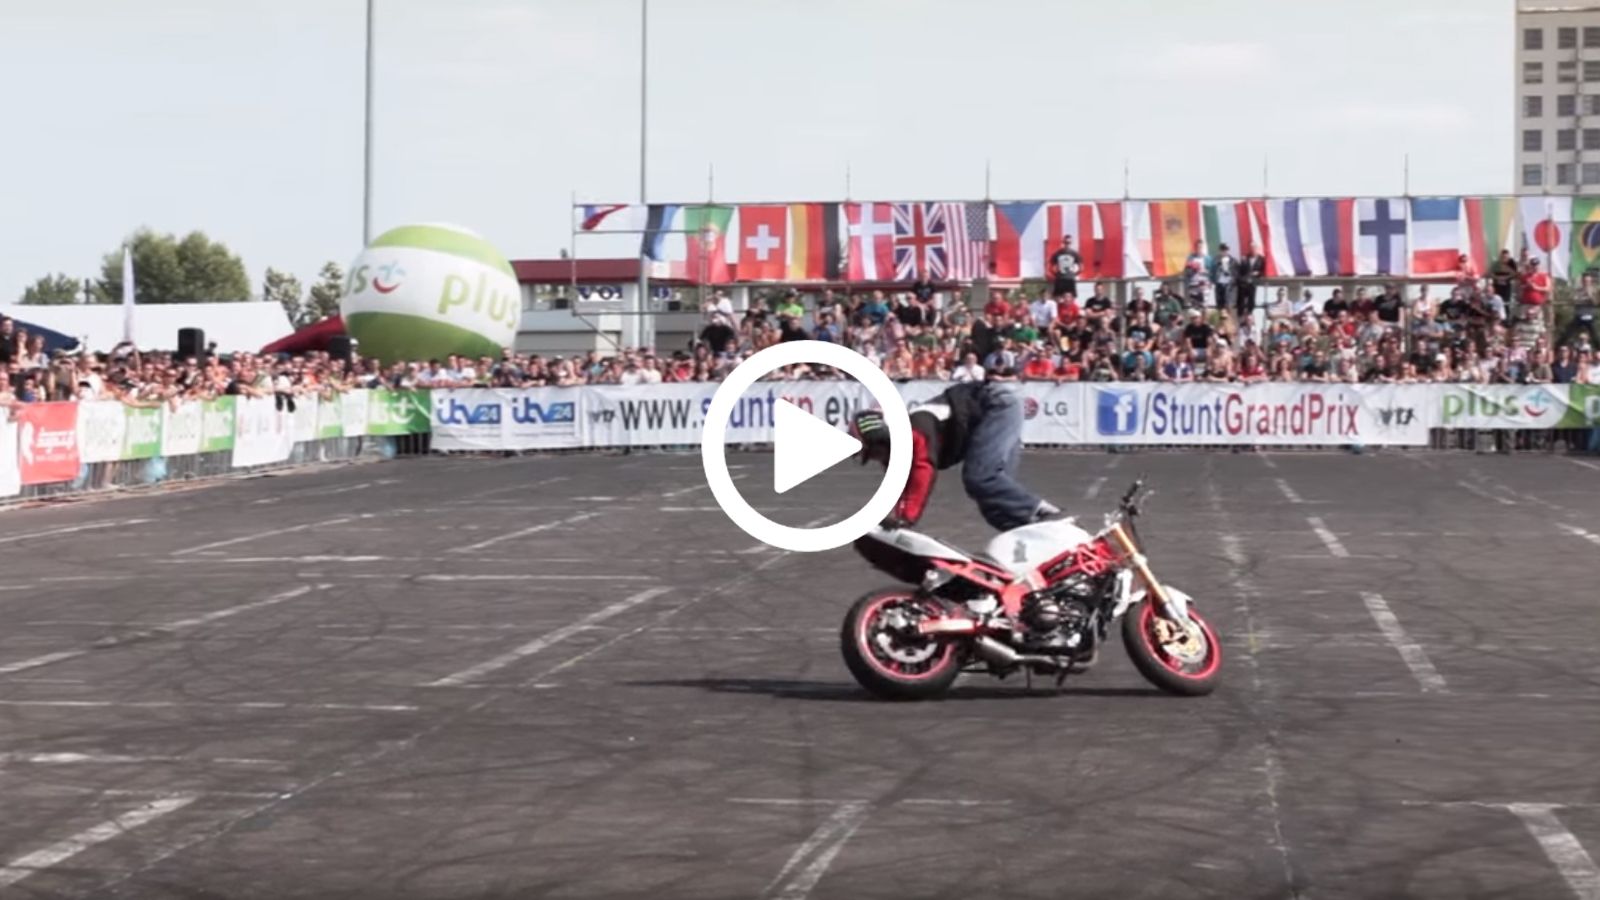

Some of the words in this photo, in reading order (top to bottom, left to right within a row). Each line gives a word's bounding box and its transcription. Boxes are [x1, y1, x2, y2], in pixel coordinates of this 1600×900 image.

[437, 274, 519, 329] plus
[1044, 402, 1068, 416] LG
[1442, 385, 1520, 424] plus
